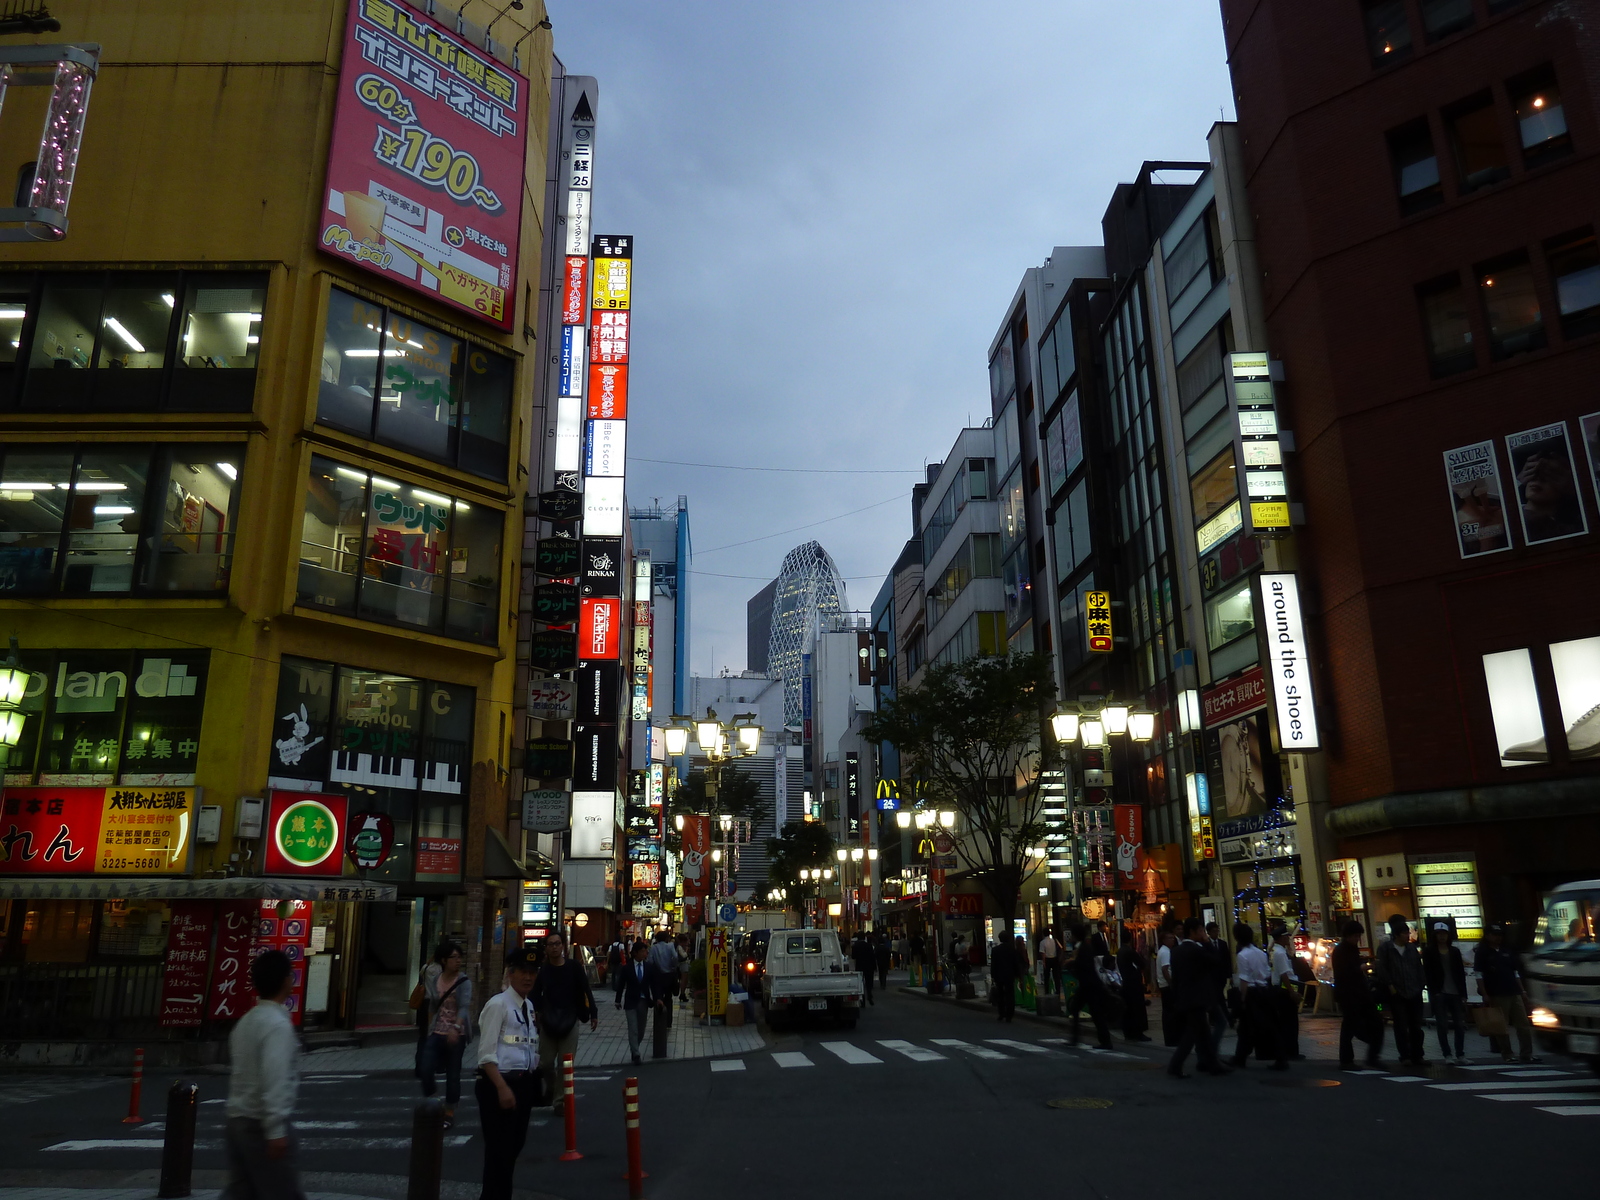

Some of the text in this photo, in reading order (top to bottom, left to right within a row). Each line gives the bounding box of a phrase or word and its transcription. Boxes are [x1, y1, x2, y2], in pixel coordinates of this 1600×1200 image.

[357, 26, 517, 136] インターネット
[573, 176, 588, 186] 25
[375, 186, 423, 219] 大塚家具
[464, 226, 508, 258] 現在地
[603, 246, 623, 255] 25
[444, 266, 502, 309] ペガサス館
[474, 296, 501, 318] 6F
[608, 299, 627, 308] 9F
[352, 301, 488, 375] MUSIC
[547, 428, 555, 438] 5
[1448, 445, 1490, 467] SAKURA
[372, 492, 448, 535] ウッド
[1462, 523, 1480, 536] 3F
[373, 527, 441, 575] 受付
[539, 550, 577, 564] ウッド
[1203, 564, 1219, 593] 3F
[536, 597, 576, 612] ウッド
[1090, 593, 1104, 606] 3F
[1088, 607, 1111, 636] 麻雀
[534, 645, 573, 659] ウッド
[1271, 581, 1304, 741] around the shoes
[297, 667, 453, 716] MUSIC
[531, 689, 571, 703] ラーメン
[532, 702, 568, 711] 肥後のれん
[342, 726, 412, 754] ウッド
[548, 743, 569, 751] School
[73, 737, 198, 760] 生徒募集中
[848, 773, 857, 797] メガネ
[532, 791, 562, 799] WOOD
[107, 814, 175, 825] 大小宴会受付中
[290, 814, 327, 833] 熊本
[104, 837, 161, 845] 味と地酒の店
[283, 834, 329, 850] らーめん
[1202, 826, 1213, 848] 麻雀
[441, 842, 459, 852] ウッド
[101, 858, 161, 869] 3225-5680
[323, 887, 377, 901] 新宿本店
[674, 897, 683, 905] B1
[167, 949, 208, 963] 新宿本店
[213, 910, 249, 1017] ひごのれん
